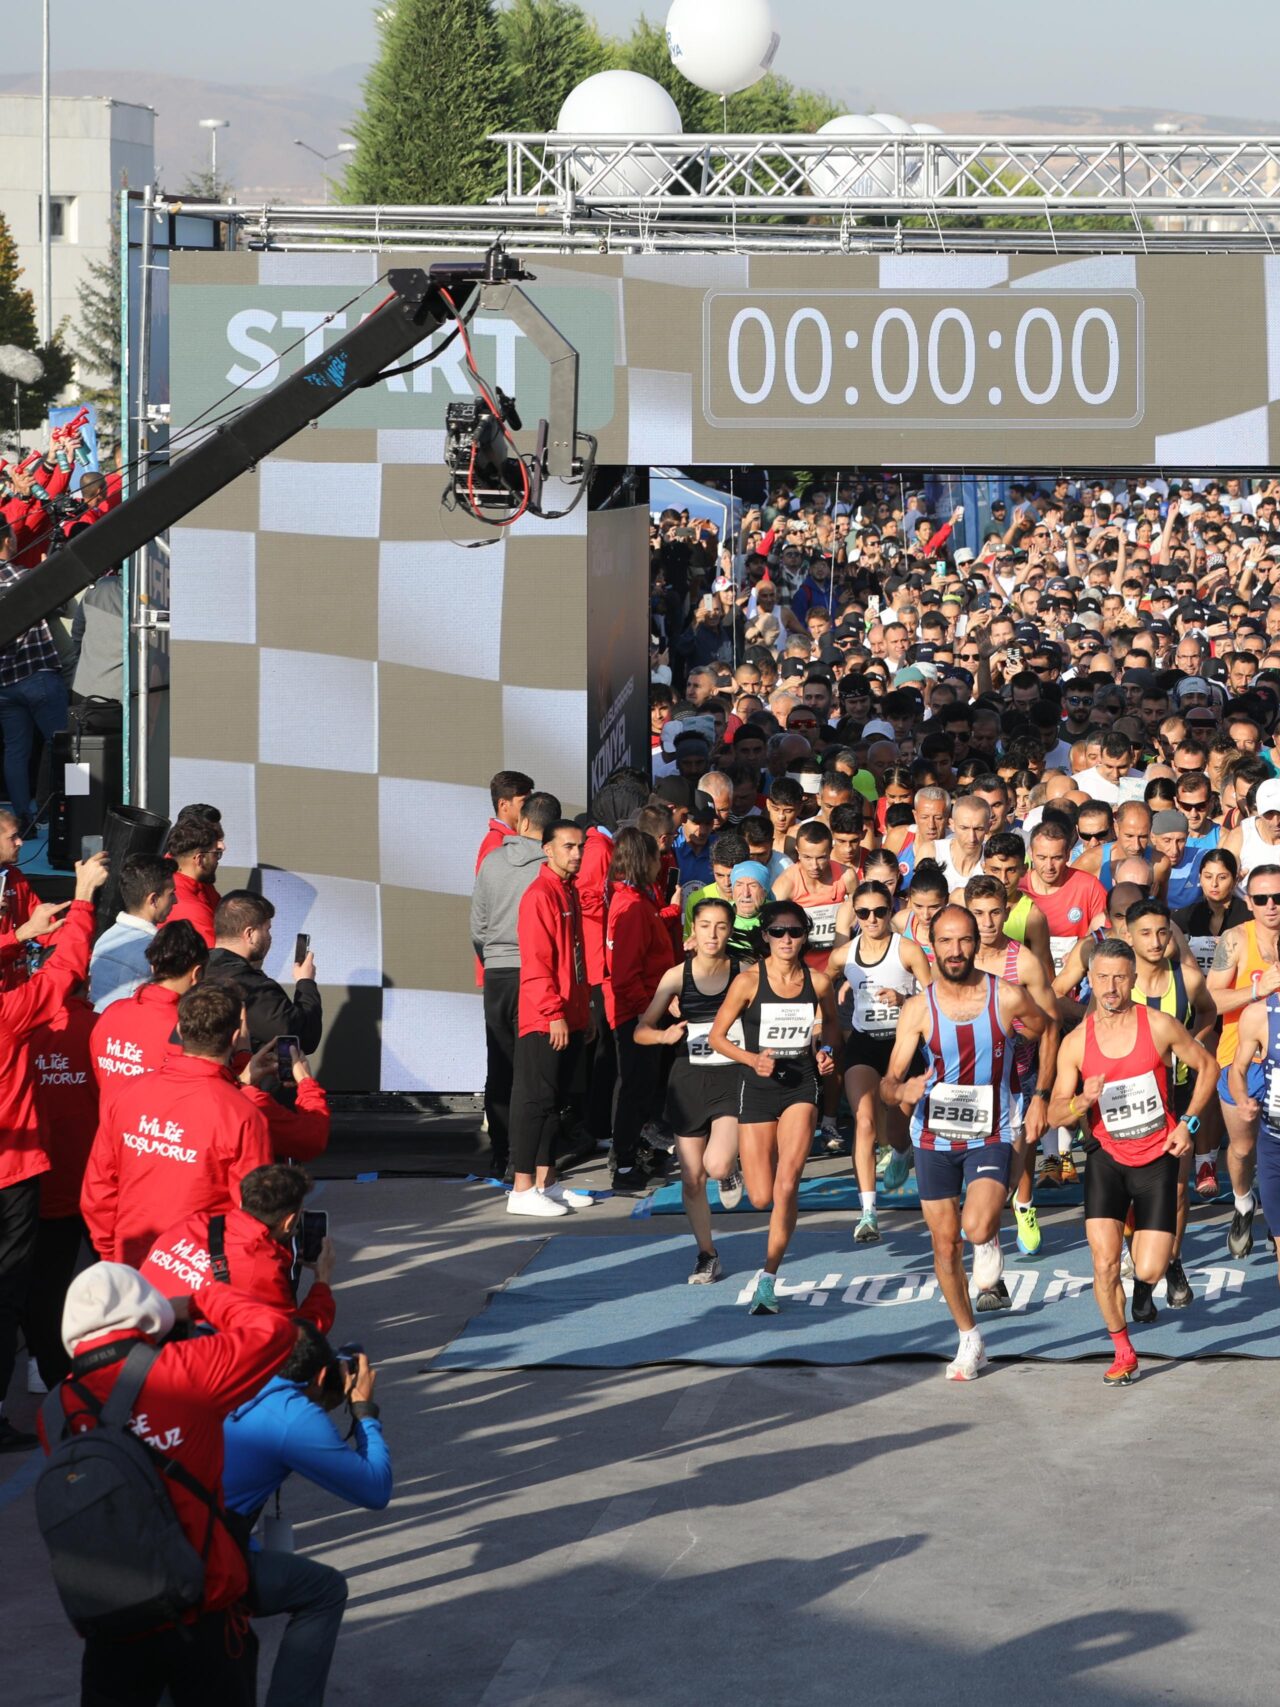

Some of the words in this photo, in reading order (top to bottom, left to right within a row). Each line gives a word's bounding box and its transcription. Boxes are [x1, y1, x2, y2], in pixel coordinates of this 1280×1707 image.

[728, 307, 1119, 404] 00:00:00
[865, 1009, 899, 1022] 232
[767, 1026, 810, 1039] 2174
[932, 1106, 989, 1123] 2388
[1106, 1096, 1157, 1123] 2945
